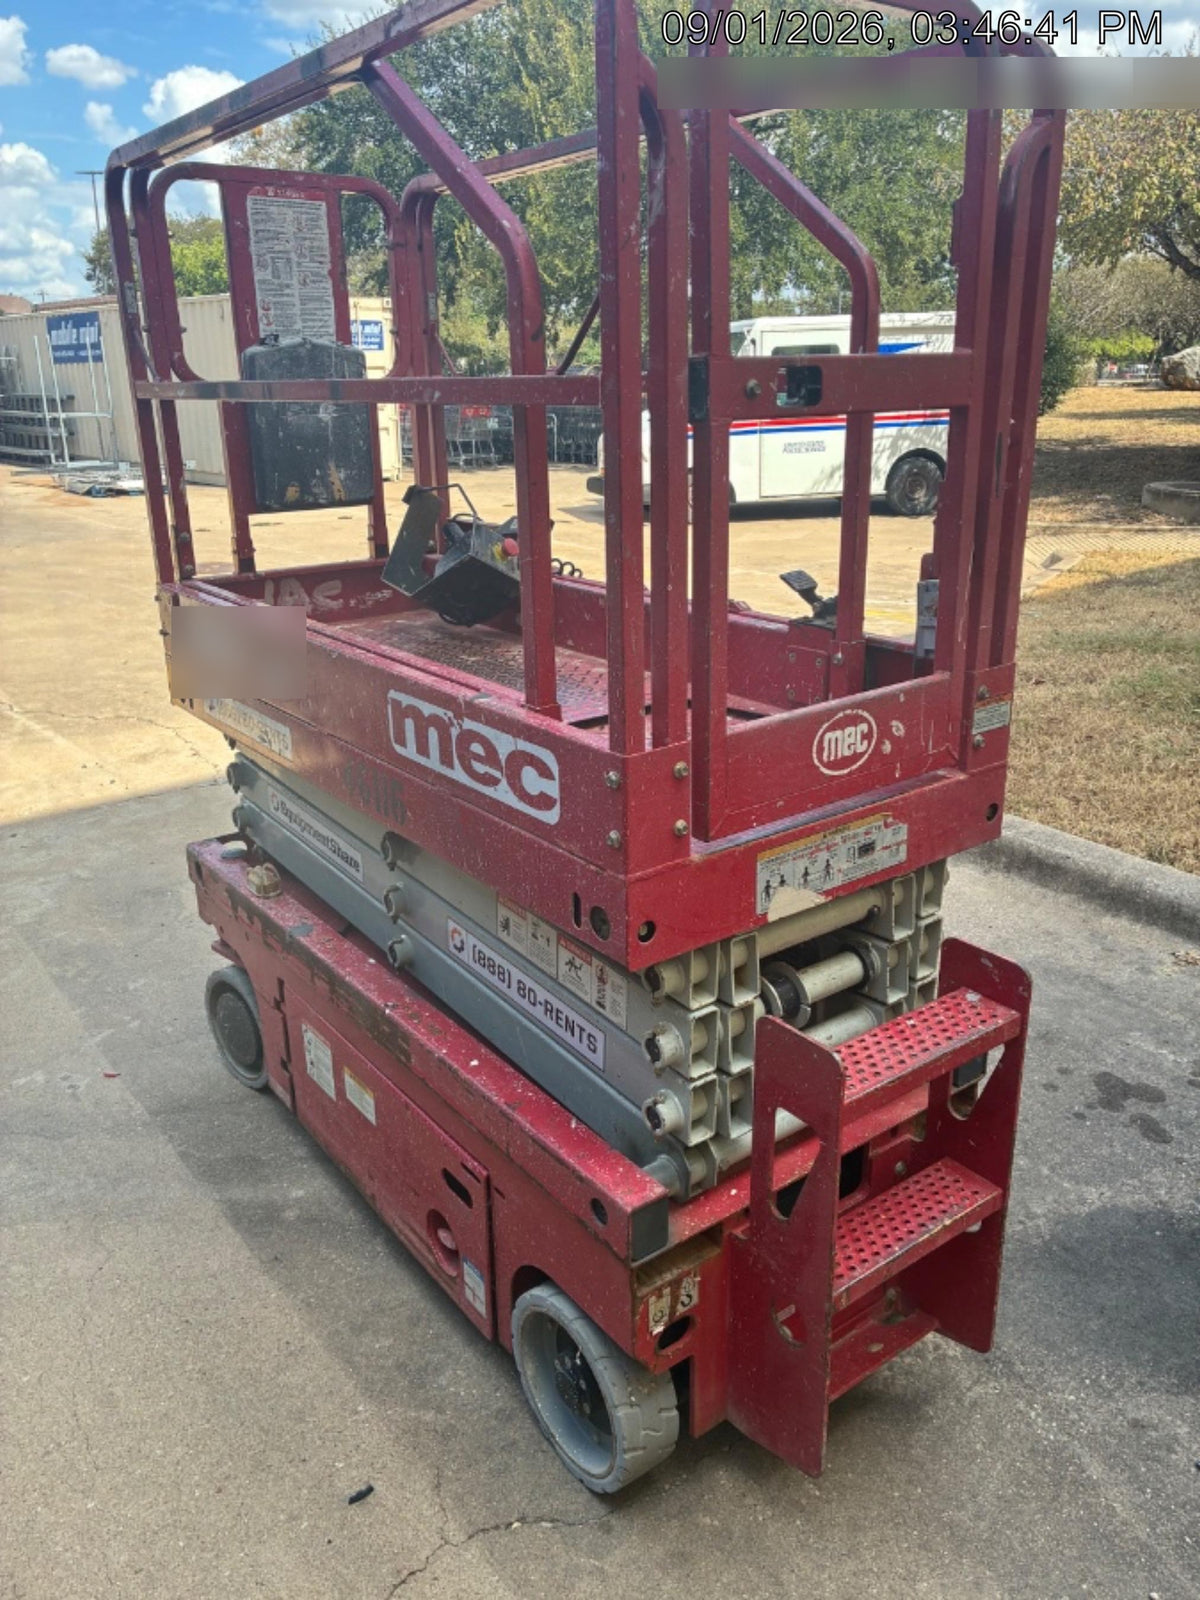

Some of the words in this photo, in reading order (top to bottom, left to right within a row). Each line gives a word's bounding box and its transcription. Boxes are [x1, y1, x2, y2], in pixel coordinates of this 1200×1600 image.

[390, 697, 558, 812] mec
[471, 943, 512, 990] (888)
[516, 978, 599, 1055] 80-RENTS
